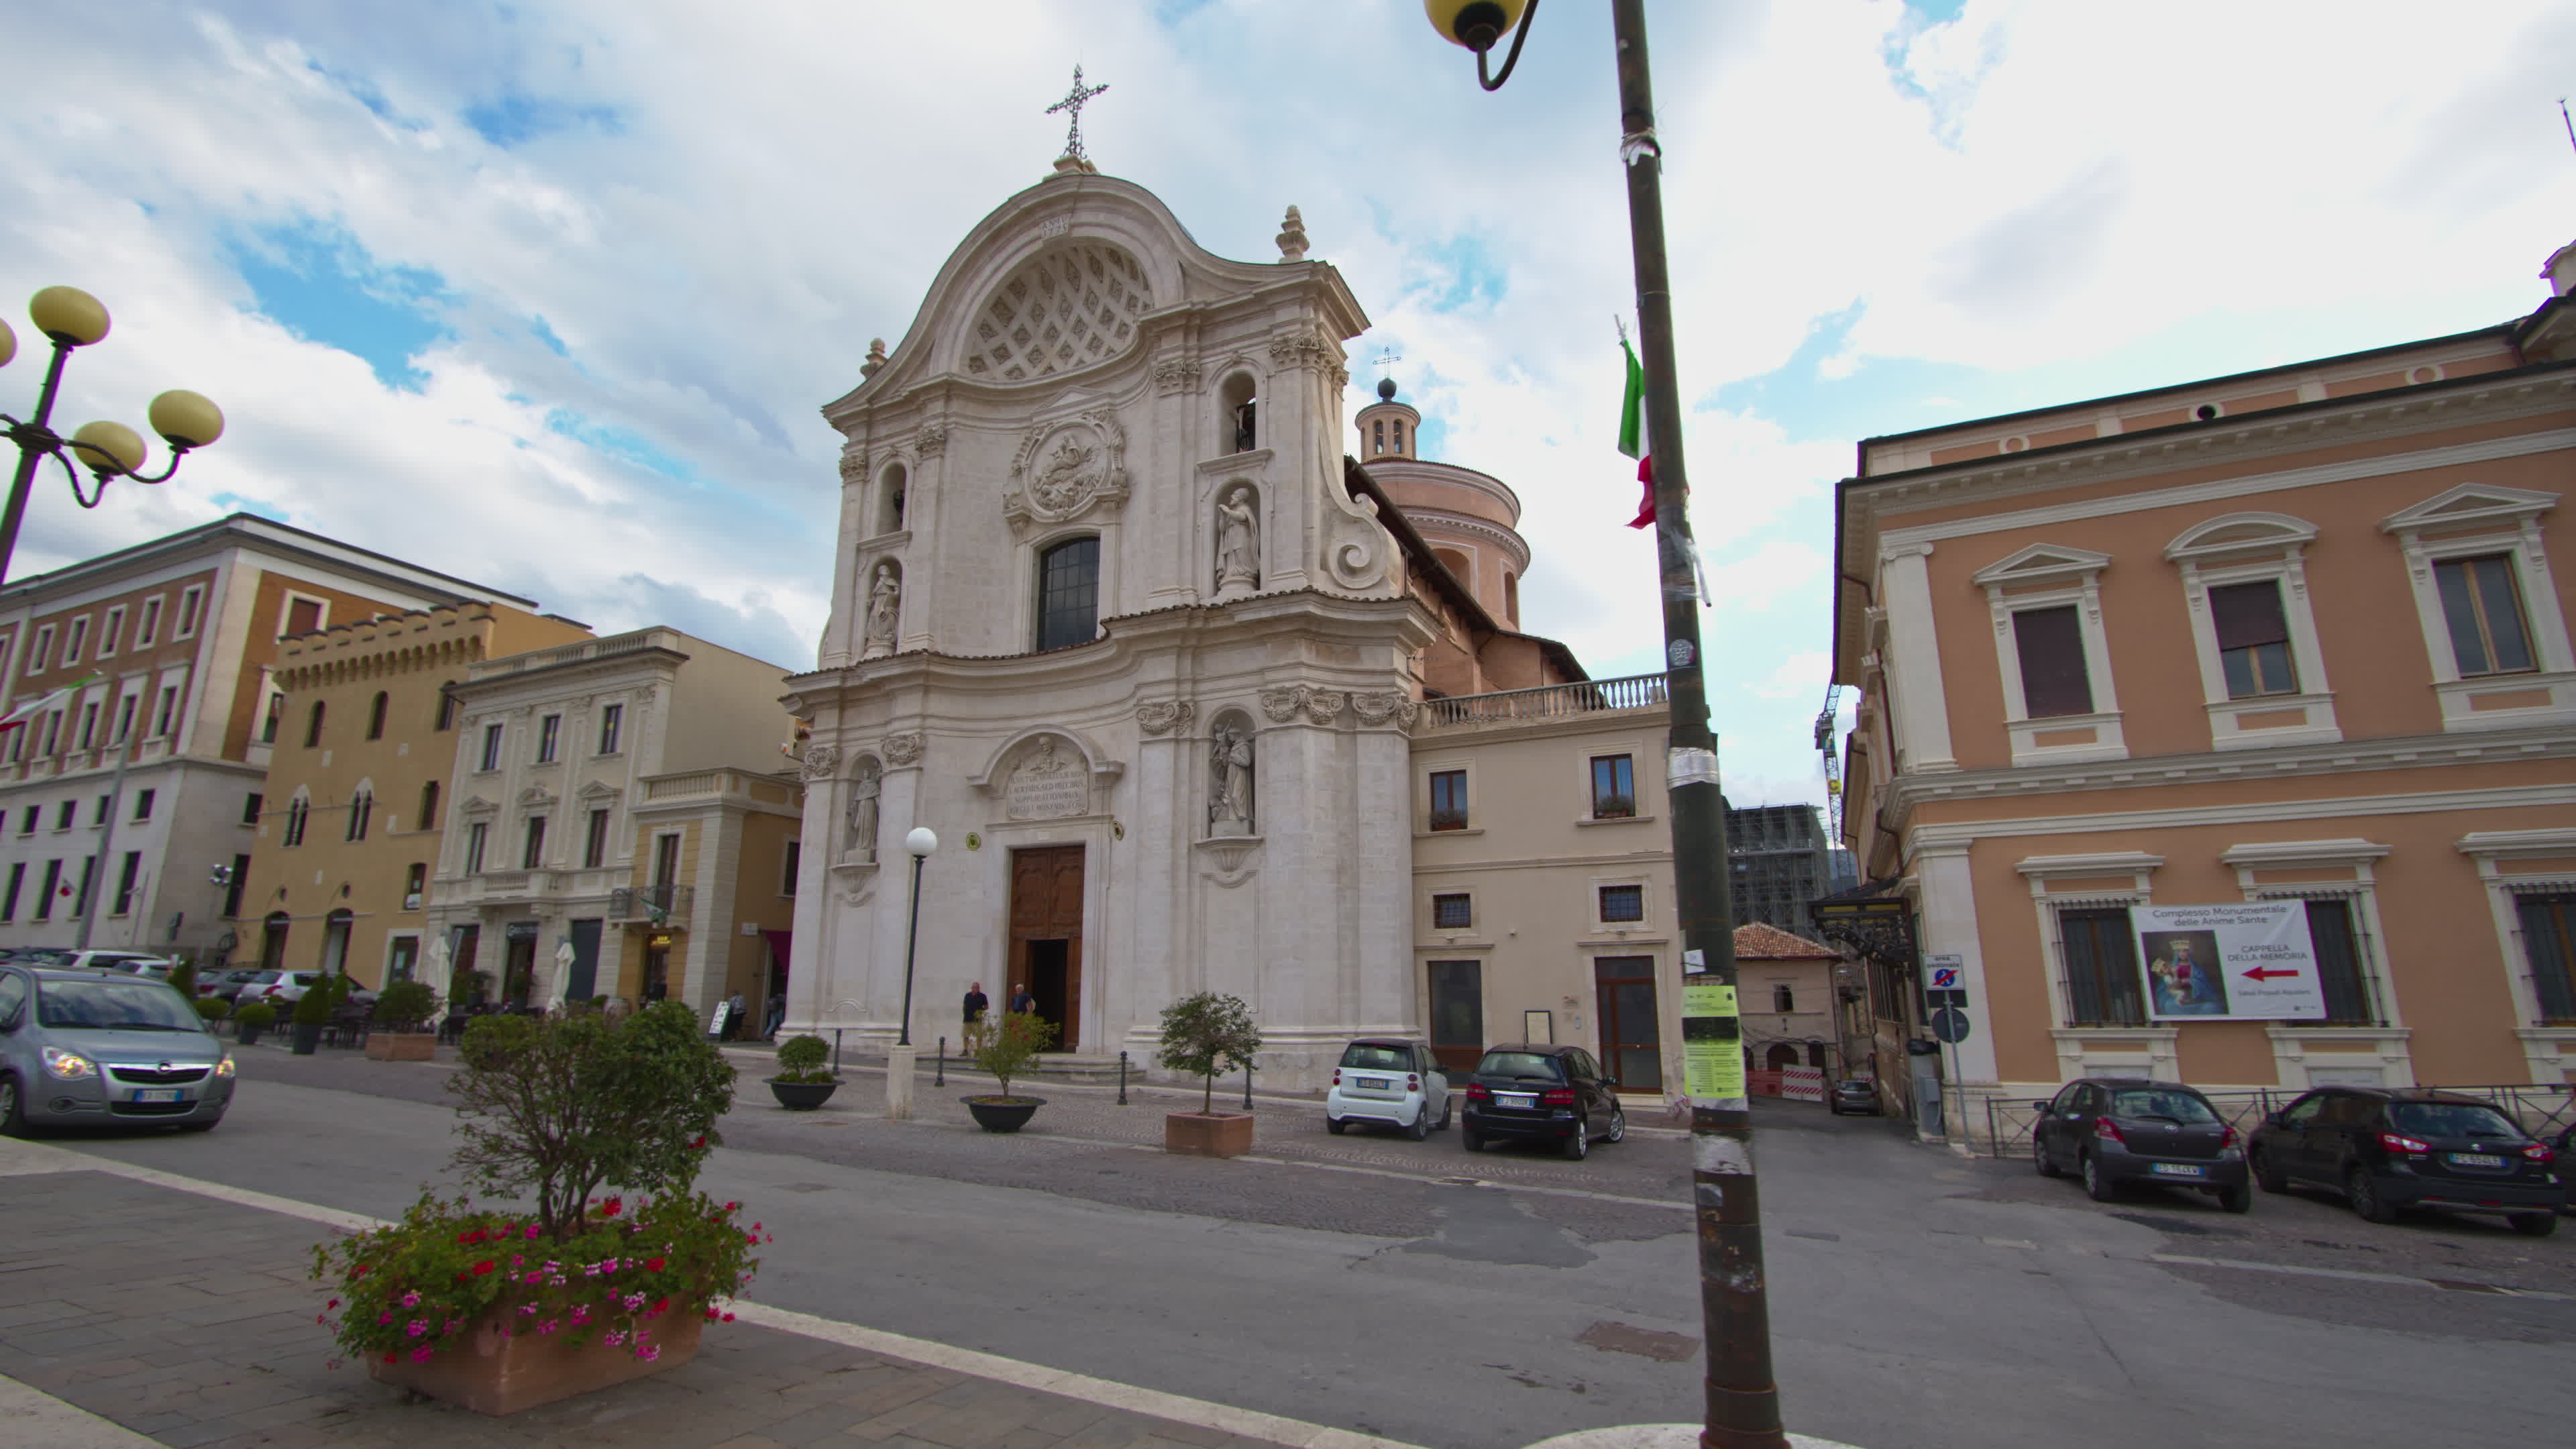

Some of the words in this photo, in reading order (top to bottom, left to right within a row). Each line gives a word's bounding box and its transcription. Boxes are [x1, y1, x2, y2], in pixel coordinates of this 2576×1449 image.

[2152, 909, 2211, 919] Complesso
[2212, 905, 2287, 915] Monumentale
[2174, 918, 2200, 927] delle
[2201, 917, 2235, 925] Anime
[2237, 915, 2269, 924] Sante
[2241, 945, 2290, 953] CAPPELLA
[2226, 954, 2259, 962] DELLA
[2259, 952, 2308, 961] MEMORIA
